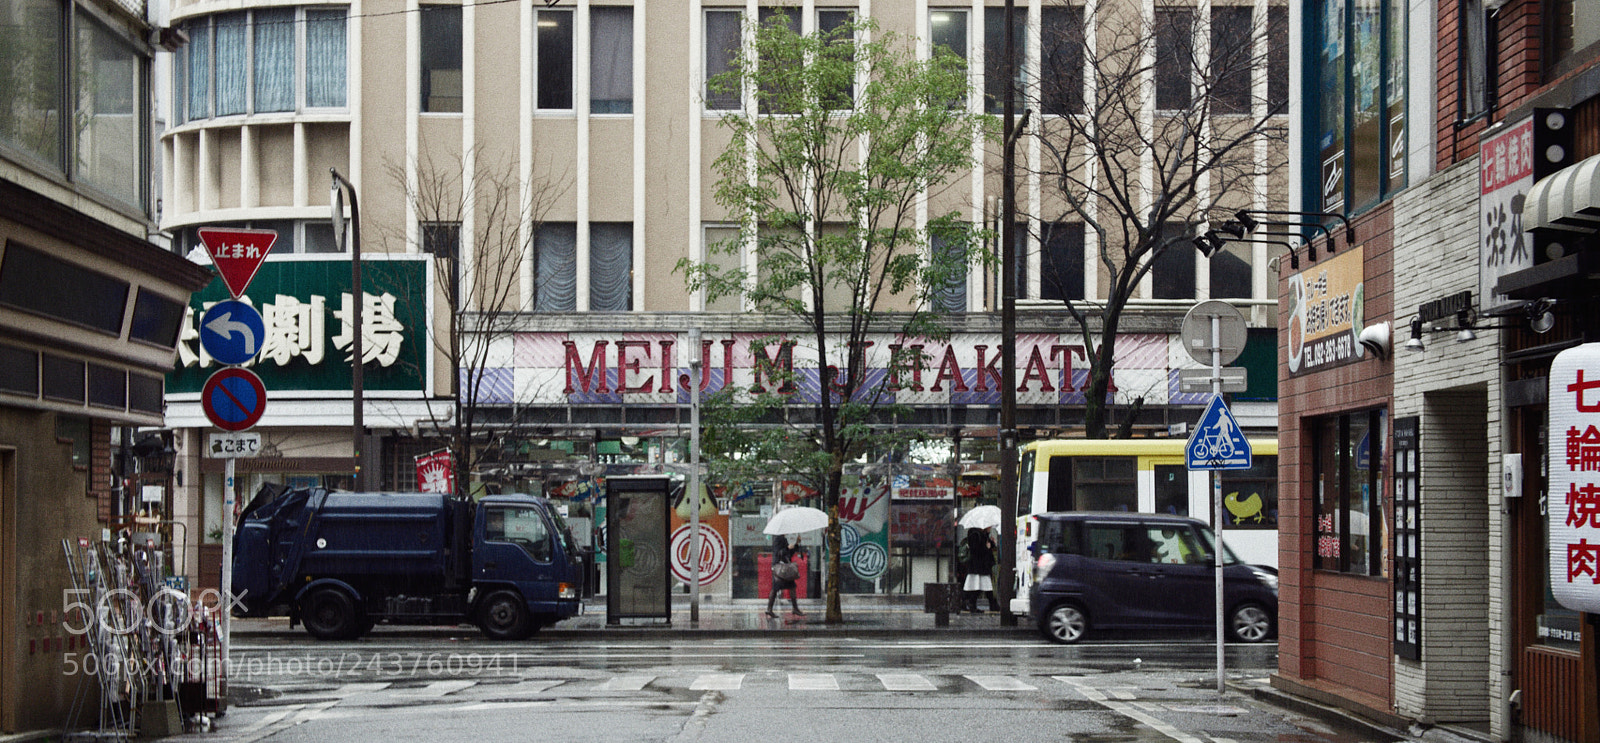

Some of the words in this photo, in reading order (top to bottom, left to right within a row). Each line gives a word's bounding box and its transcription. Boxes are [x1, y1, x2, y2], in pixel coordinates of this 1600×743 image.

[1483, 129, 1532, 188] 七輪焼肉
[214, 242, 262, 260] 止まれ
[562, 340, 735, 395] MEIJI
[241, 458, 299, 472] Information
[1565, 369, 1600, 585] 七輪焼肉
